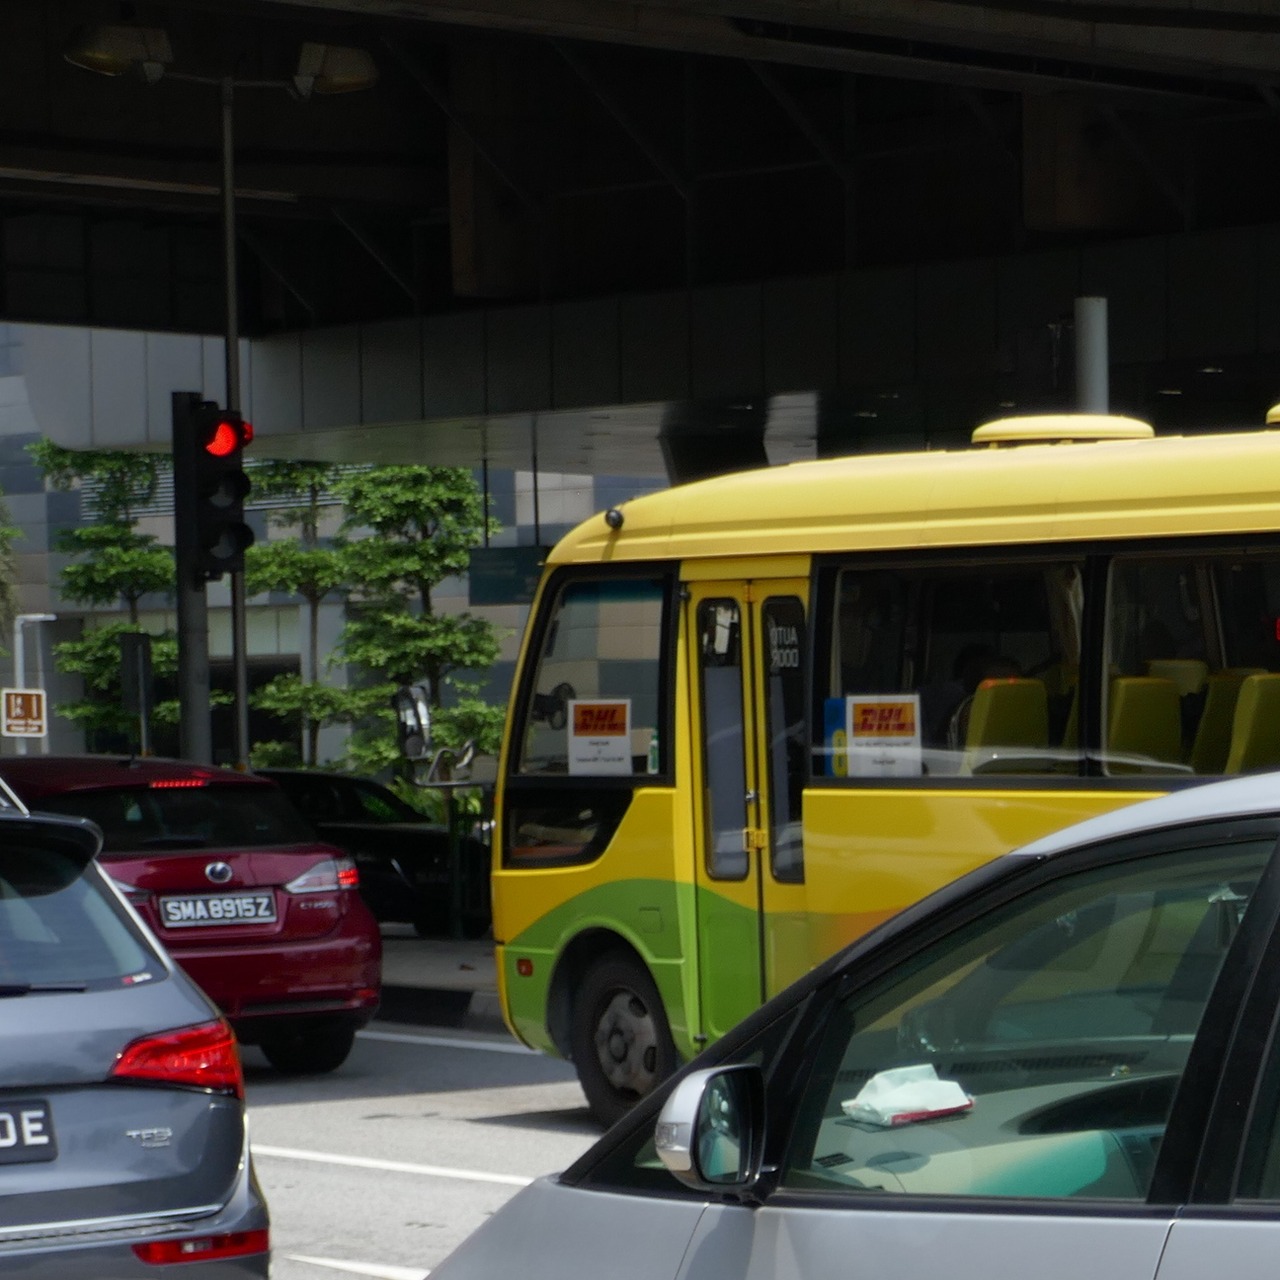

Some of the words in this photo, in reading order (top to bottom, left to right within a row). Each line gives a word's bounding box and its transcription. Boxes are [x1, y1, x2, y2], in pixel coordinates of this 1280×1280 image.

[580, 709, 619, 731] DHL
[860, 707, 906, 731] DHL
[166, 897, 271, 922] SMA8915Z
